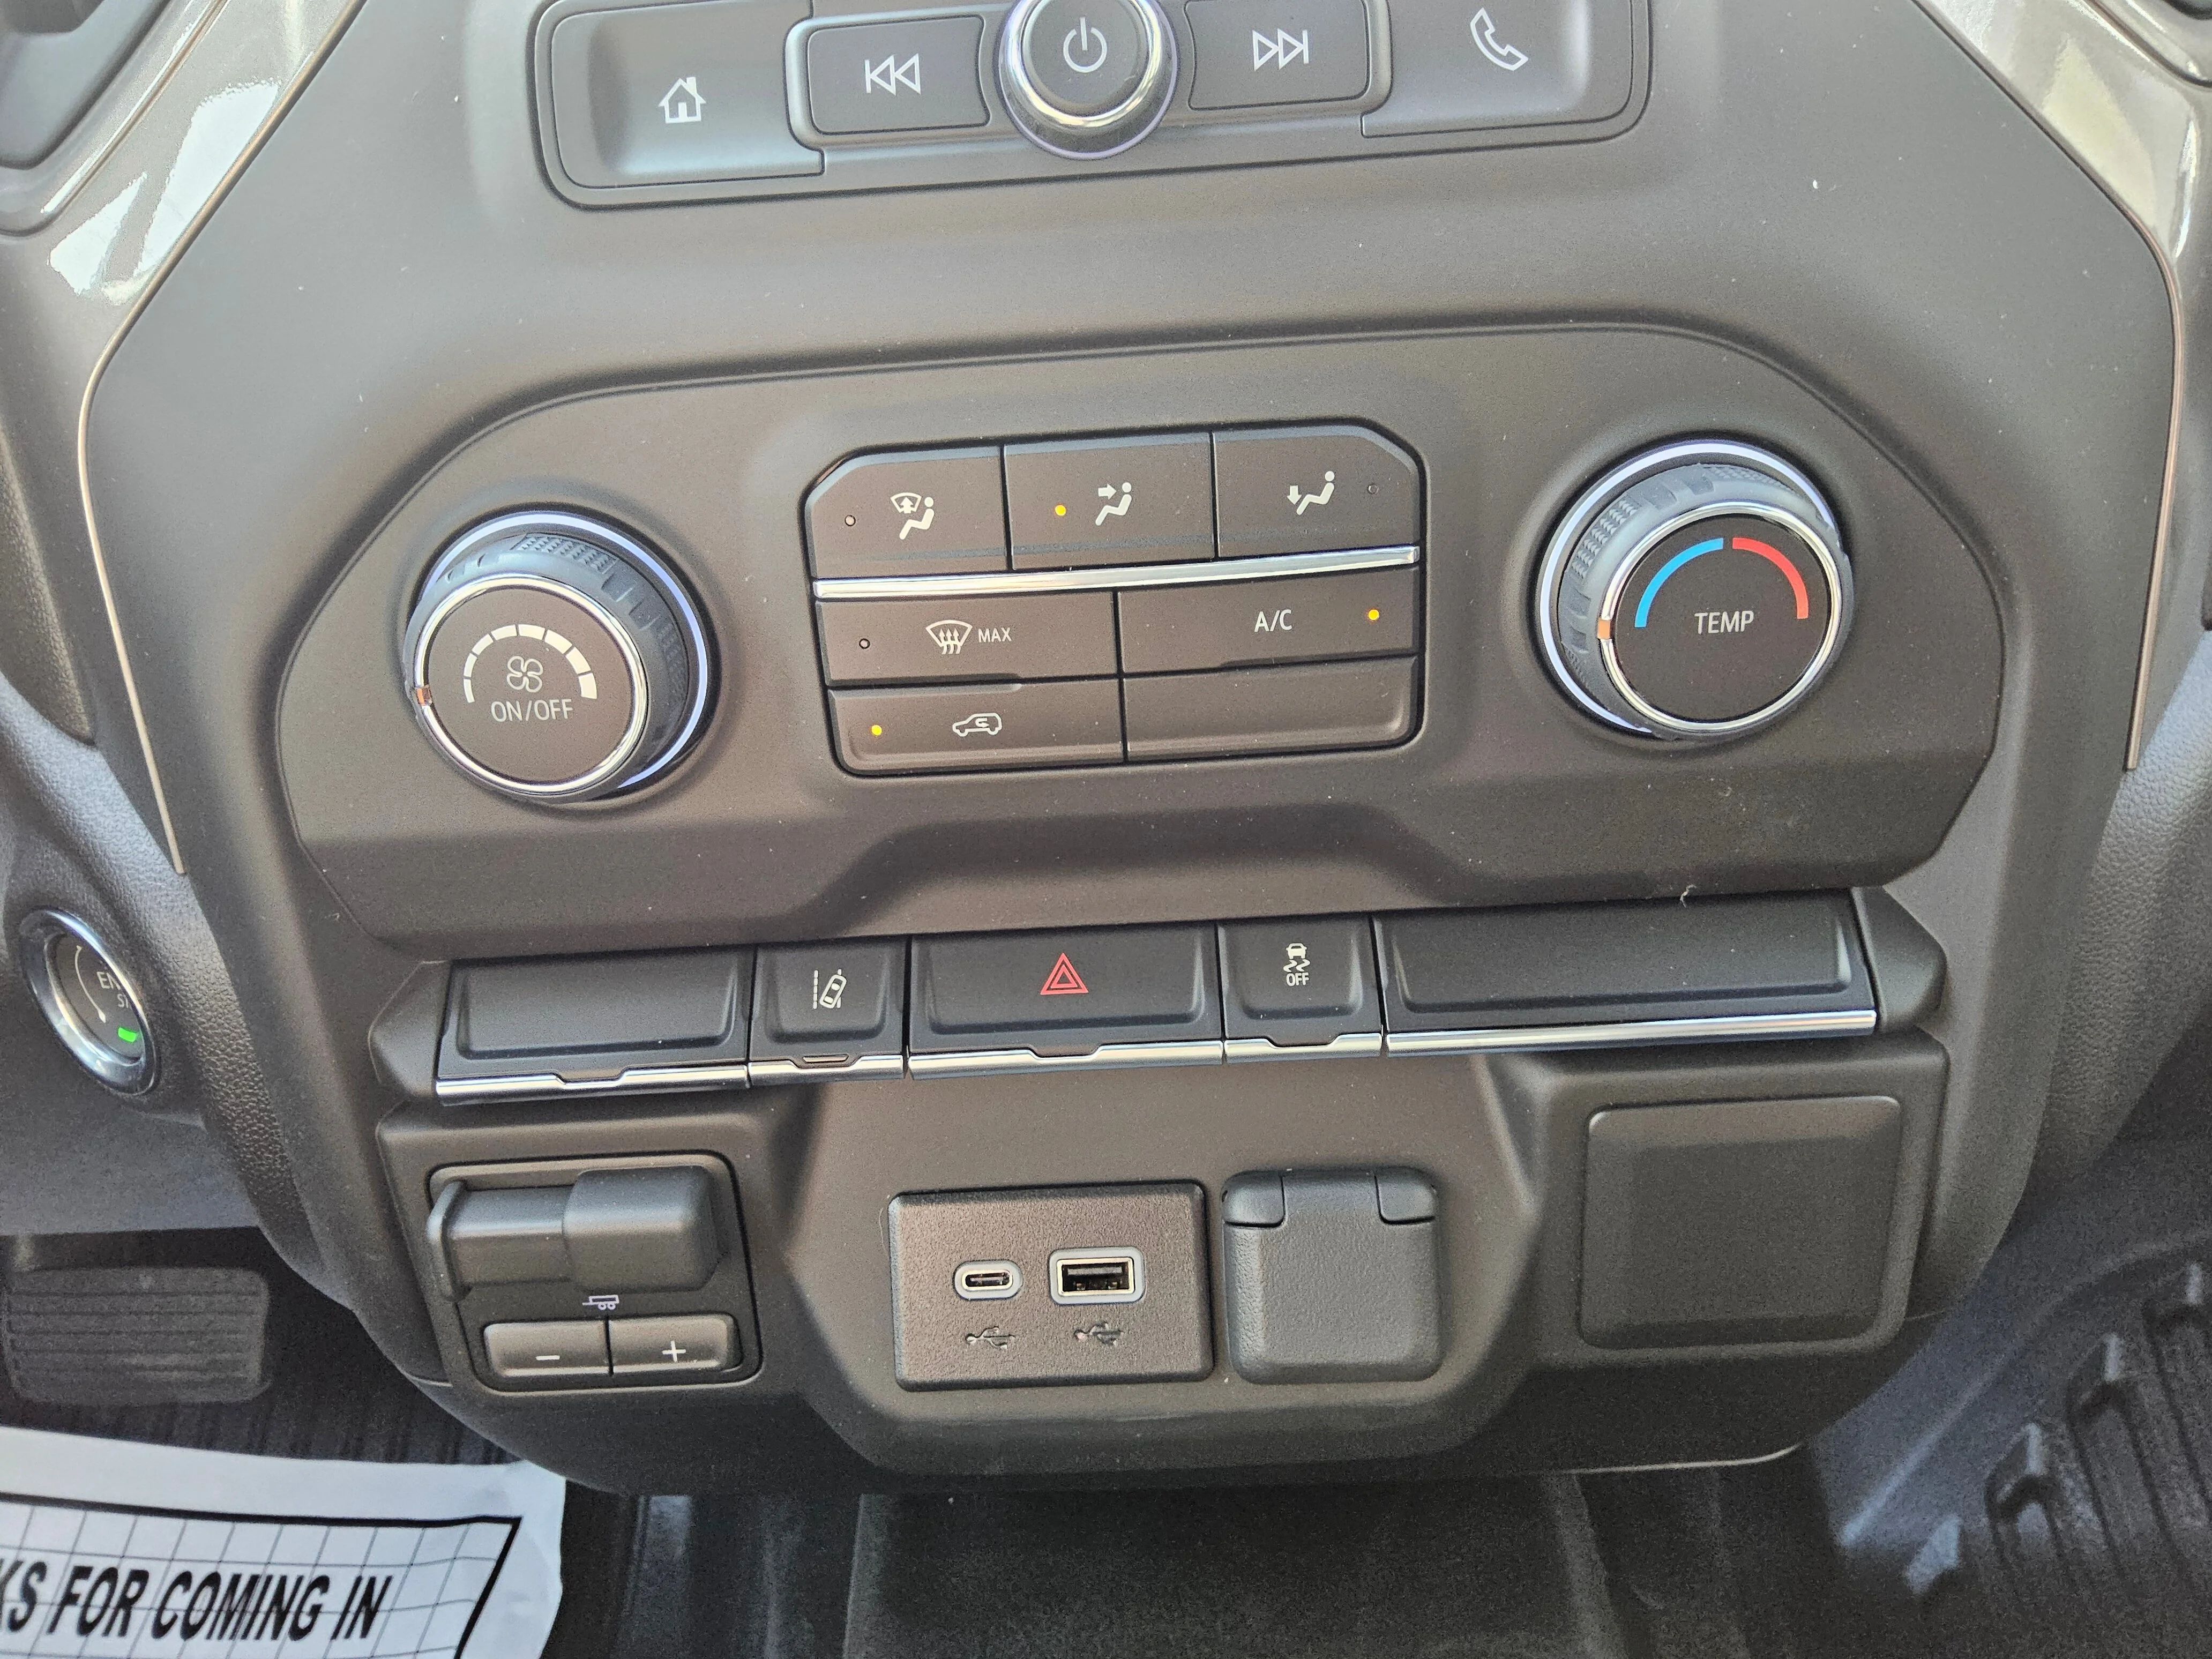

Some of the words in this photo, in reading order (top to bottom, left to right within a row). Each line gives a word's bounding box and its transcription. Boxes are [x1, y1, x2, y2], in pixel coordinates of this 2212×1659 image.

[1254, 609, 1292, 632] A/C
[1694, 610, 1754, 634] TEMP
[978, 627, 1012, 642] MAX
[491, 699, 573, 722] ON/OFF
[1286, 973, 1309, 986] OFF
[46, 1566, 150, 1637] FOR
[151, 1571, 330, 1641] COMING
[331, 1575, 393, 1640] IN
